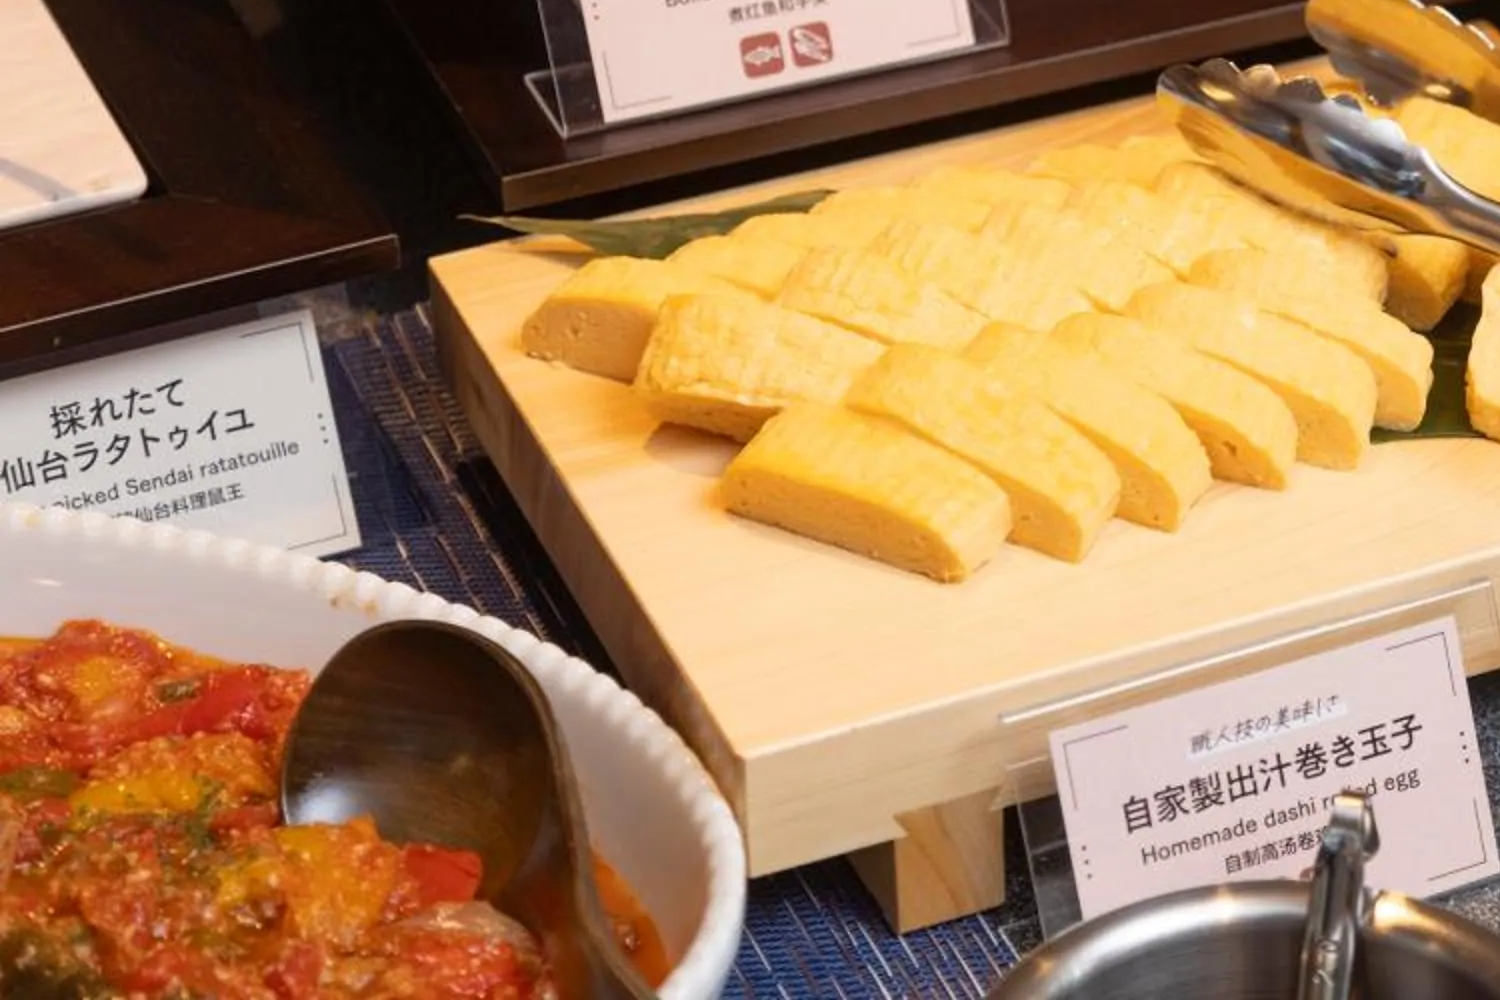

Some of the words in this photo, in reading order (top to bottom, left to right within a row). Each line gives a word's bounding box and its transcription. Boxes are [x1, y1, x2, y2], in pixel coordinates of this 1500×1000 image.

[0, 408, 255, 493] 仙台ラタトゥイユ
[50, 378, 184, 439] 採れたて
[125, 465, 193, 496] Sendai
[200, 440, 300, 477] ratatouille
[1122, 714, 1423, 834] 自家製出汁巻き玉子
[1141, 817, 1258, 866] Homemade
[1263, 797, 1316, 829] dashi
[1384, 768, 1421, 792] egg
